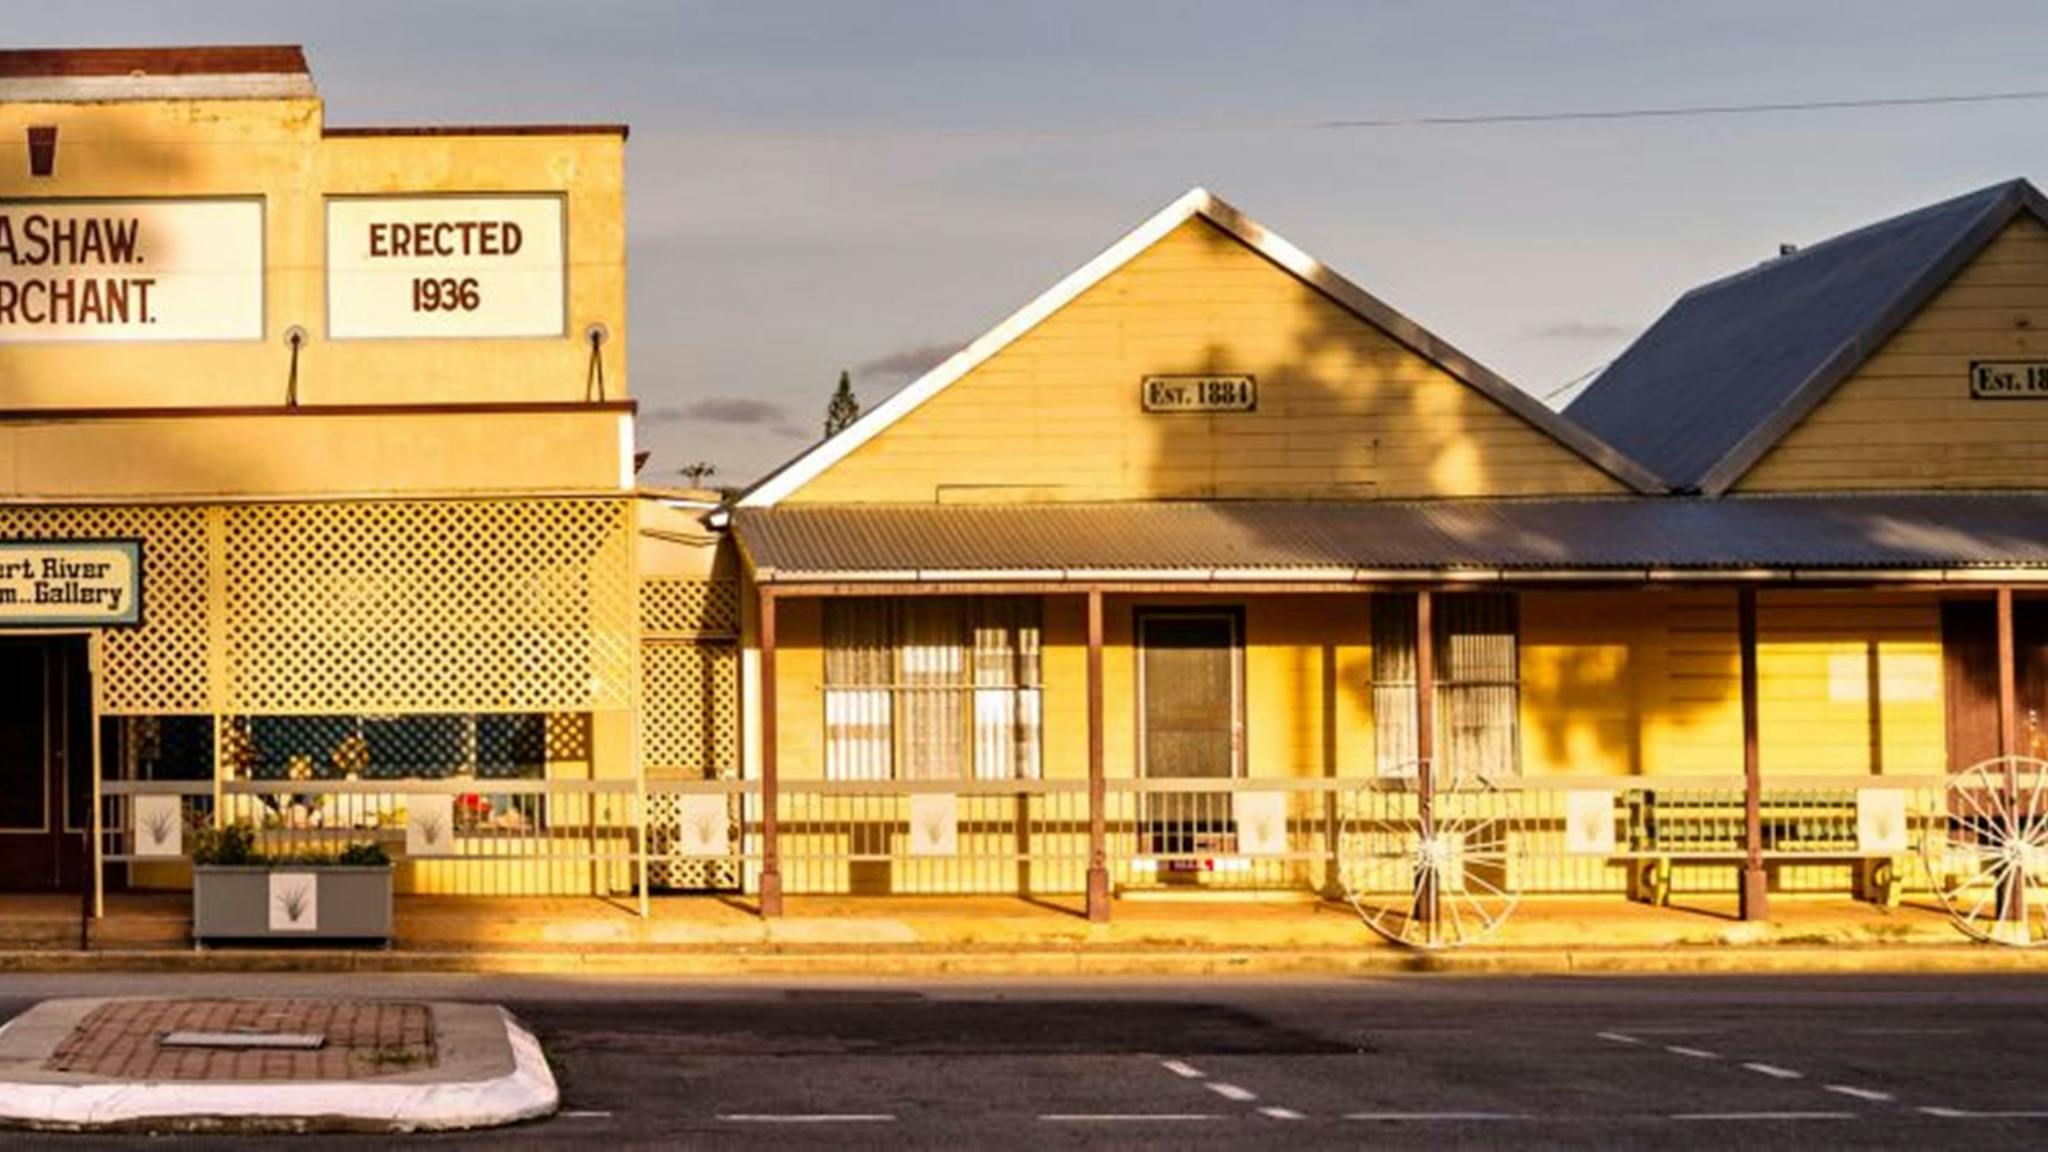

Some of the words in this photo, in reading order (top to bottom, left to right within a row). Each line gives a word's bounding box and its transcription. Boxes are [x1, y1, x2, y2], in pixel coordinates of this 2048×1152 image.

[369, 221, 522, 257] ERECTED
[413, 278, 480, 312] 1936
[41, 558, 111, 579] River
